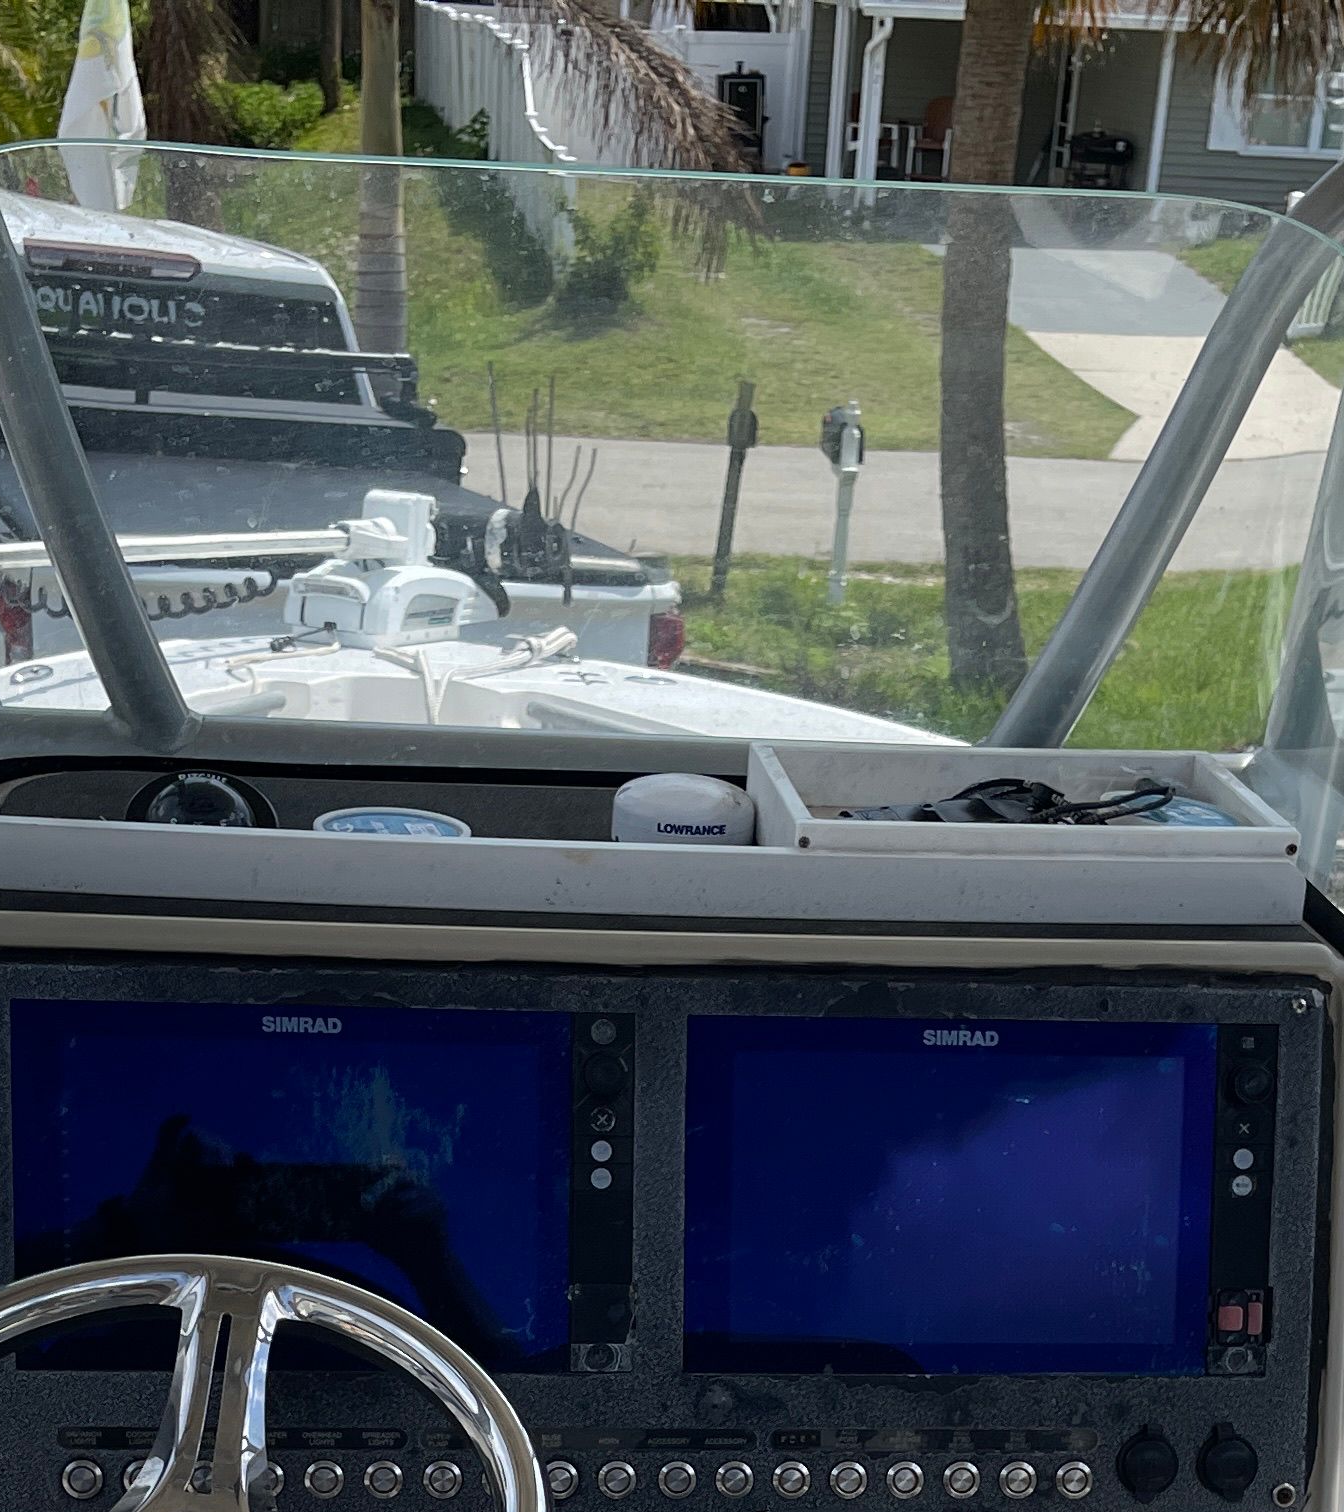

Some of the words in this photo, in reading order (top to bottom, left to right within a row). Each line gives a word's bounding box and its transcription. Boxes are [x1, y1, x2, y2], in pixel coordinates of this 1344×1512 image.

[657, 822, 726, 836] LOWRANCE
[262, 1016, 342, 1033] SIMRAD
[923, 1030, 999, 1046] SIMRAD
